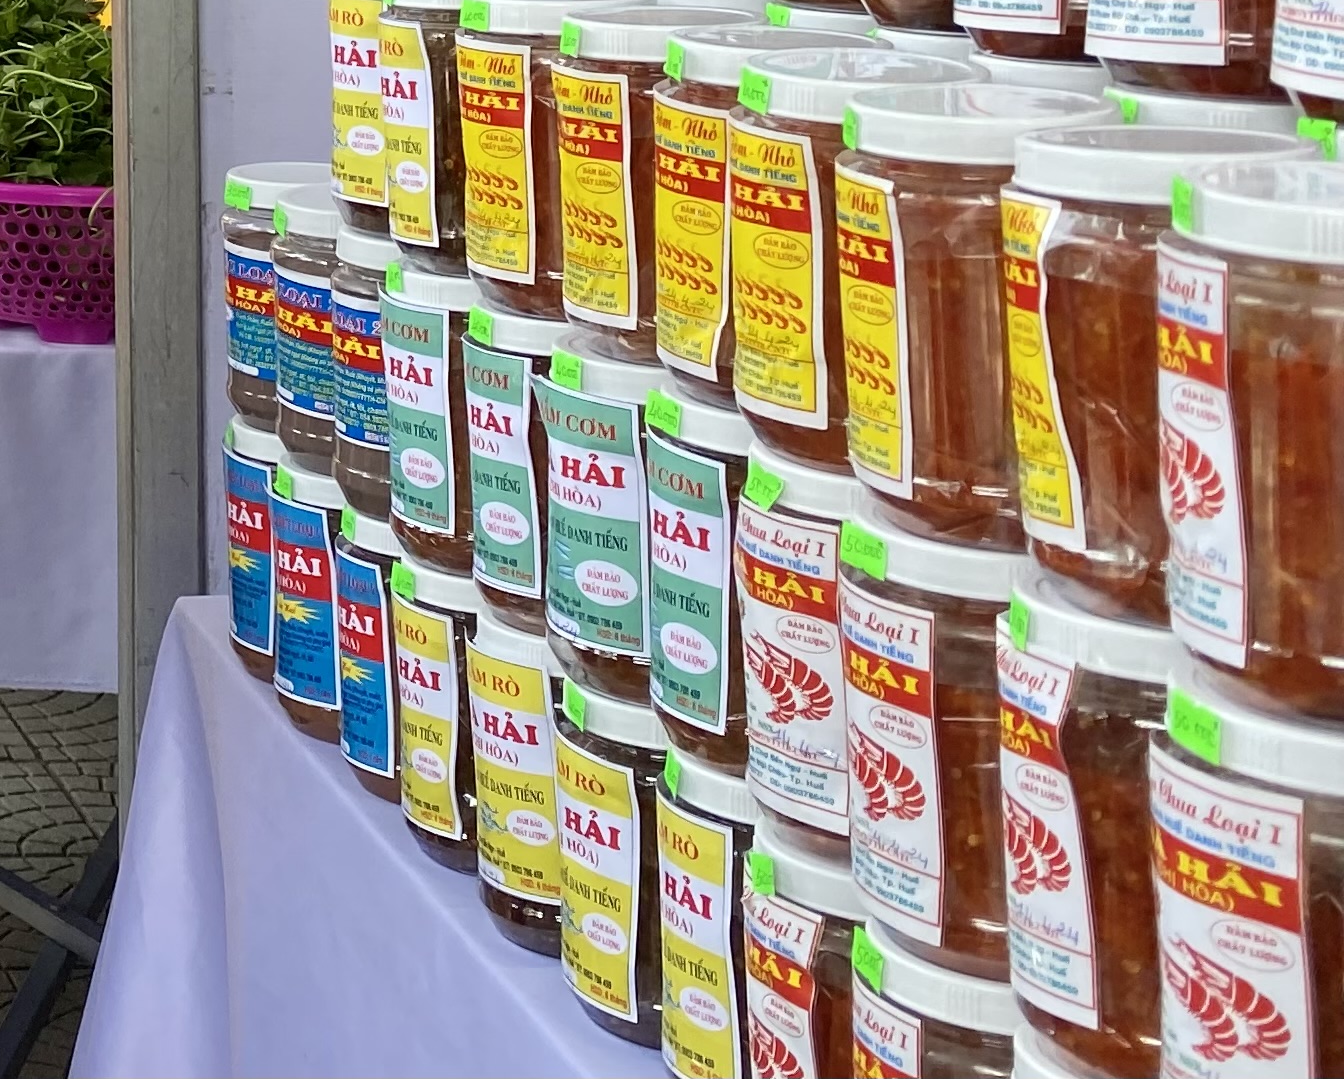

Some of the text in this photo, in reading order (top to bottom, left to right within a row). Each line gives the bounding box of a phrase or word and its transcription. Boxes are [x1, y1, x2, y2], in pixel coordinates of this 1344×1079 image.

[343, 8, 364, 26] RÒ
[334, 40, 377, 68] HẢI
[384, 37, 404, 56] RÒ
[355, 101, 379, 120] TIẾNG
[464, 90, 520, 111] HẢI
[659, 152, 721, 183] HẢI
[734, 182, 805, 212] HẢI
[392, 321, 429, 344] CƠM
[389, 355, 434, 387] HẢI
[472, 365, 509, 390] CƠM
[414, 420, 438, 442] TIẾNG
[470, 402, 514, 437] HẢI
[566, 414, 617, 442] CƠM
[494, 472, 521, 495] TIẾNG
[560, 453, 626, 489] HẢI
[658, 467, 705, 500] CƠM
[563, 486, 602, 512] HÒA)
[228, 501, 264, 530] HẢI
[568, 528, 628, 552] DANH TIẾNG
[653, 509, 711, 552] HẢI
[771, 528, 811, 559] Loại
[278, 547, 322, 577] HẢI
[786, 556, 821, 575] TIẾNG
[753, 566, 826, 605] HẢI
[757, 588, 794, 611] HÒA)
[679, 591, 710, 618] TIẾNG
[405, 620, 428, 646] RÒ
[864, 611, 904, 644] Loại
[398, 657, 442, 692] HẢI
[492, 676, 521, 698] RÒ
[850, 649, 919, 696] HẢI
[419, 724, 444, 747] TIẾNG
[482, 711, 539, 746] HẢI
[485, 739, 519, 767] HÒA)
[514, 781, 545, 806] TIẾNG
[574, 772, 606, 797] RÒ
[564, 804, 621, 851] HẢI
[1202, 805, 1261, 844] Loại
[566, 836, 600, 868] HÒA)
[672, 834, 700, 860] RÒ
[1176, 850, 1283, 908] HẢI
[593, 886, 621, 913] TIẾNG
[665, 871, 713, 920] HẢI
[1182, 878, 1235, 912] HÒA)
[756, 907, 792, 939] Loại
[688, 958, 718, 987] TIẾNG
[864, 1009, 896, 1045] Loại
